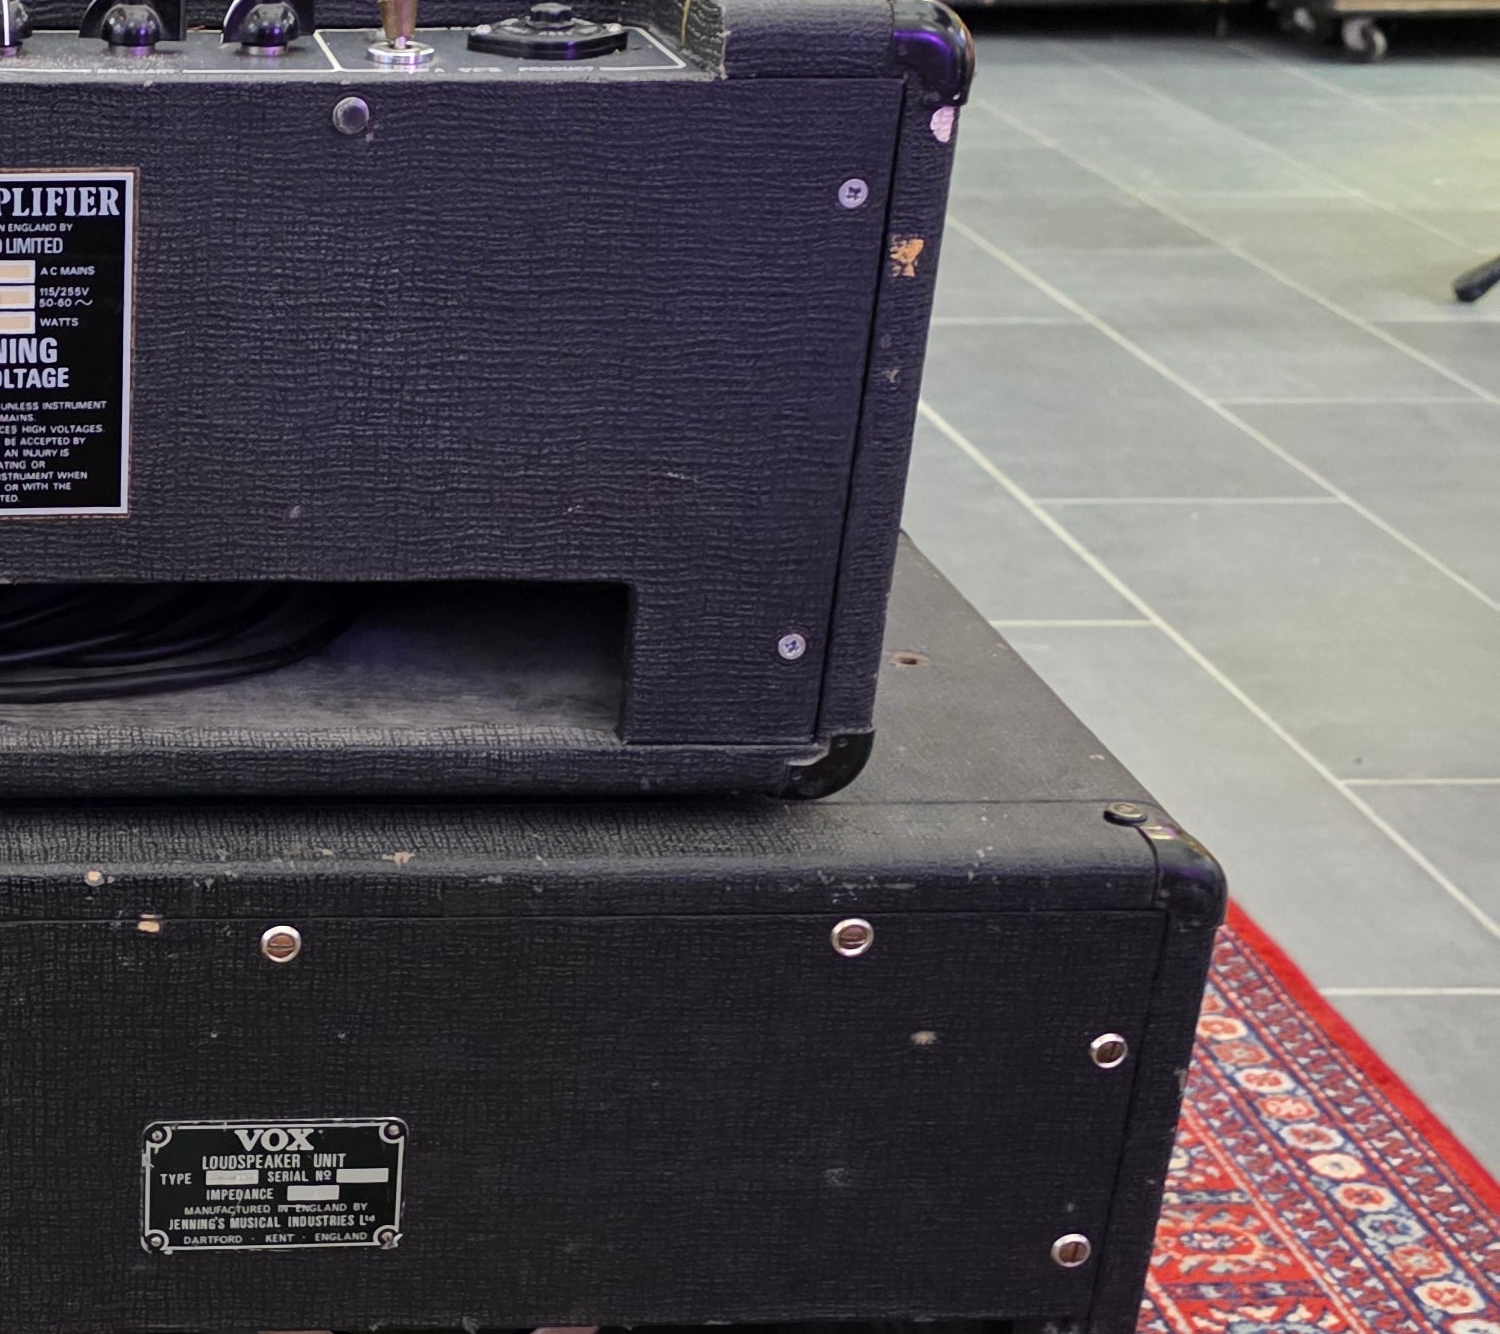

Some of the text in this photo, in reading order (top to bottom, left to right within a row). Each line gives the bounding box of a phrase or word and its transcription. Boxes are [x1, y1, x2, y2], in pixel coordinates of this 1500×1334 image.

[8, 223, 56, 232] ENGLAND
[60, 223, 73, 232] BY
[6, 237, 63, 254] LIMITED
[60, 267, 95, 276] MAINS
[39, 298, 71, 308] 50-60
[40, 318, 79, 327] WATTS
[0, 402, 39, 411] UNLESS
[42, 400, 107, 410] INSTRUMENT
[22, 425, 46, 434] HIGH
[4, 438, 17, 446] BE
[20, 437, 71, 446] ACCEPTED
[73, 437, 86, 446] BY
[4, 449, 19, 458] AN
[23, 448, 58, 458] INJURY
[60, 448, 70, 457] IS
[31, 460, 46, 469] OR
[57, 471, 87, 480] WHEN
[4, 483, 19, 492] OR
[22, 482, 49, 491] WITH
[53, 482, 72, 491] THE
[235, 1128, 314, 1152] VOX
[202, 1153, 346, 1170] LOUDSPEAKER UNIT
[160, 1173, 192, 1185] TYPE
[267, 1171, 309, 1183] SERIAL
[206, 1188, 274, 1201] IMPEDANCE
[184, 1202, 368, 1215] MANUFACTURED IN ENGLAND BY
[169, 1217, 226, 1231] JENNING'S
[230, 1216, 281, 1229] MUSICAL
[287, 1215, 355, 1228] INDUSTRIES
[183, 1231, 368, 1245] DARTFORD KENT ENGLAND
